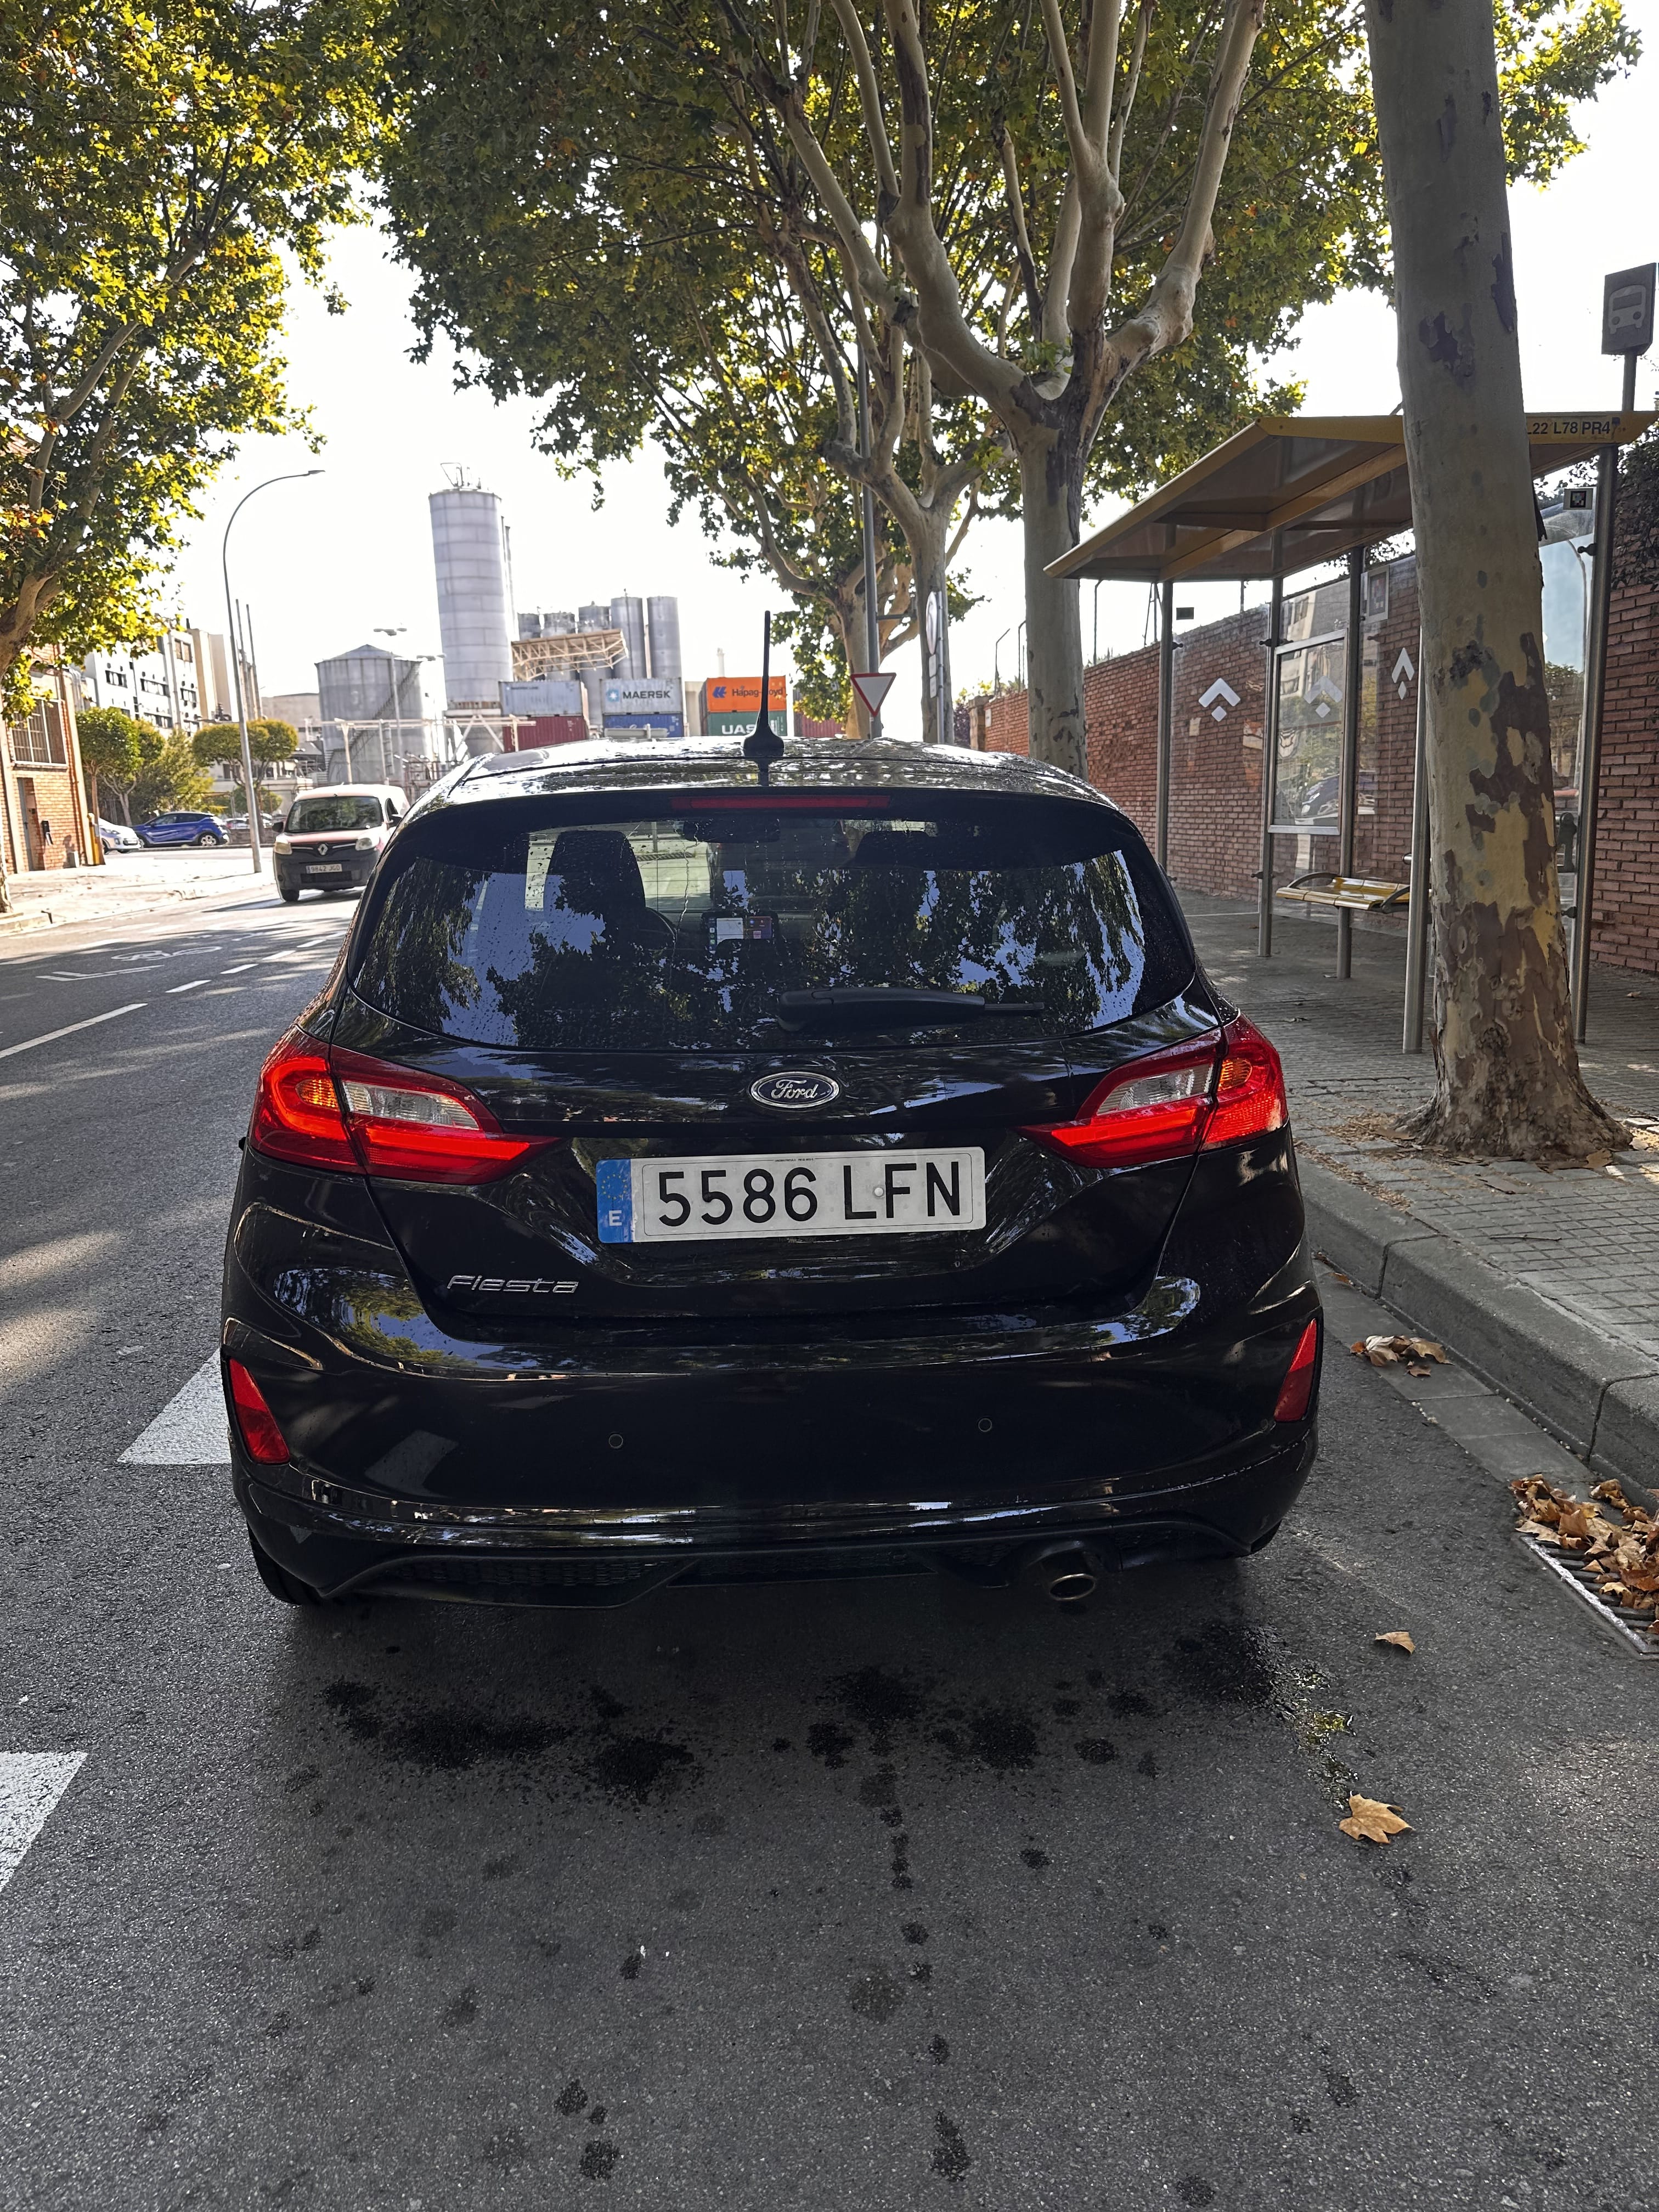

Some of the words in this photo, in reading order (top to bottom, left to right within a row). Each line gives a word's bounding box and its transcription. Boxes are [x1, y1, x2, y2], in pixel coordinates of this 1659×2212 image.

[1554, 422, 1578, 434] L78
[1582, 421, 1610, 435] PR4
[623, 691, 670, 699] MAERSK
[732, 687, 783, 697] Hapag-oyd
[721, 724, 756, 735] UAS
[771, 1079, 819, 1099] Ford
[658, 1167, 818, 1227] 5586
[843, 1161, 960, 1220] LFN
[609, 1210, 622, 1226] E
[447, 1275, 579, 1293] Fiesta
